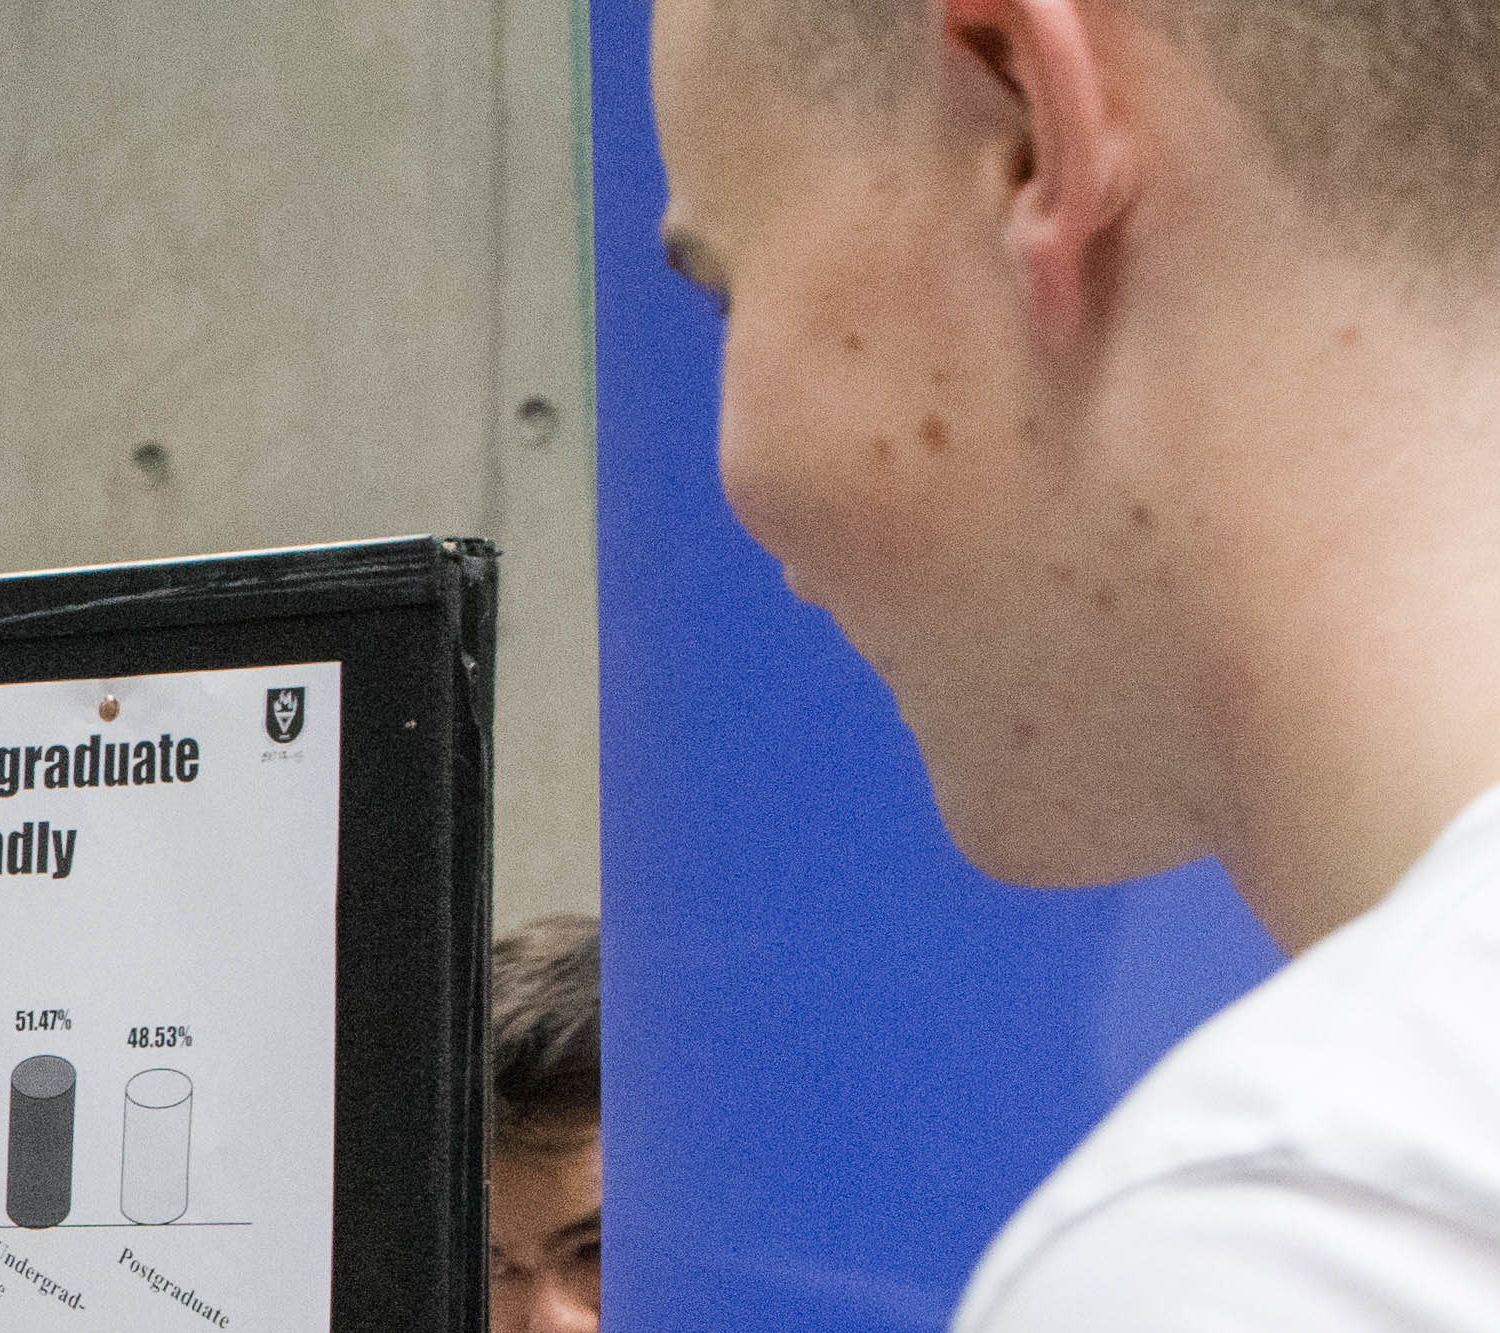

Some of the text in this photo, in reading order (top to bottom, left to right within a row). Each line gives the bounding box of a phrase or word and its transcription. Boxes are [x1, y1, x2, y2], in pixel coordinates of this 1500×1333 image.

[15, 1009, 73, 1031] 51.47%
[126, 1026, 192, 1048] 48.53%
[117, 1247, 229, 1329] Postgraduate
